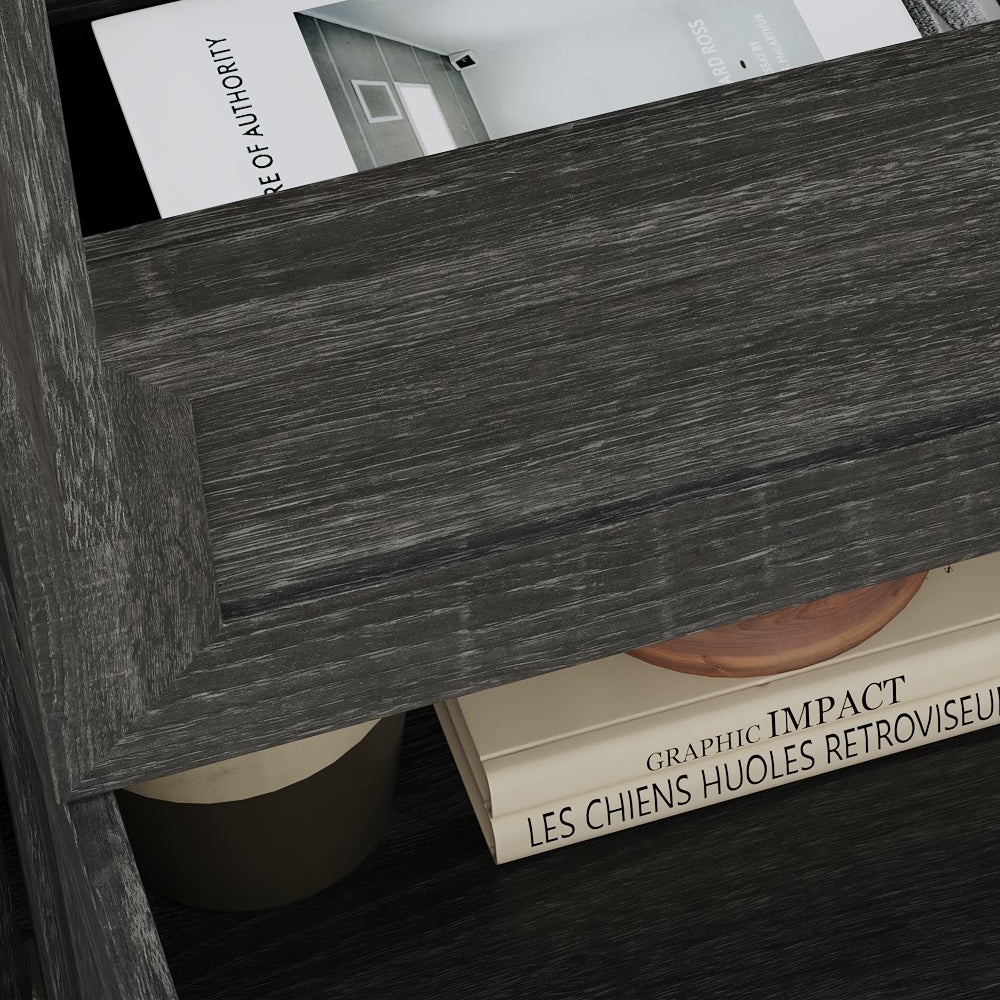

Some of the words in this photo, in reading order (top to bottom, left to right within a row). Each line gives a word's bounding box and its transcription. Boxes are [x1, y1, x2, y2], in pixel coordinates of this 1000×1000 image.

[688, 18, 719, 56] ROSS
[205, 37, 264, 137] AUTHORITY
[246, 144, 274, 169] OF
[647, 724, 761, 772] GRAPHIC
[767, 675, 907, 739] IMPACT
[527, 806, 575, 848] LES
[586, 774, 692, 831] CHIENS
[701, 740, 816, 799] HUOLES
